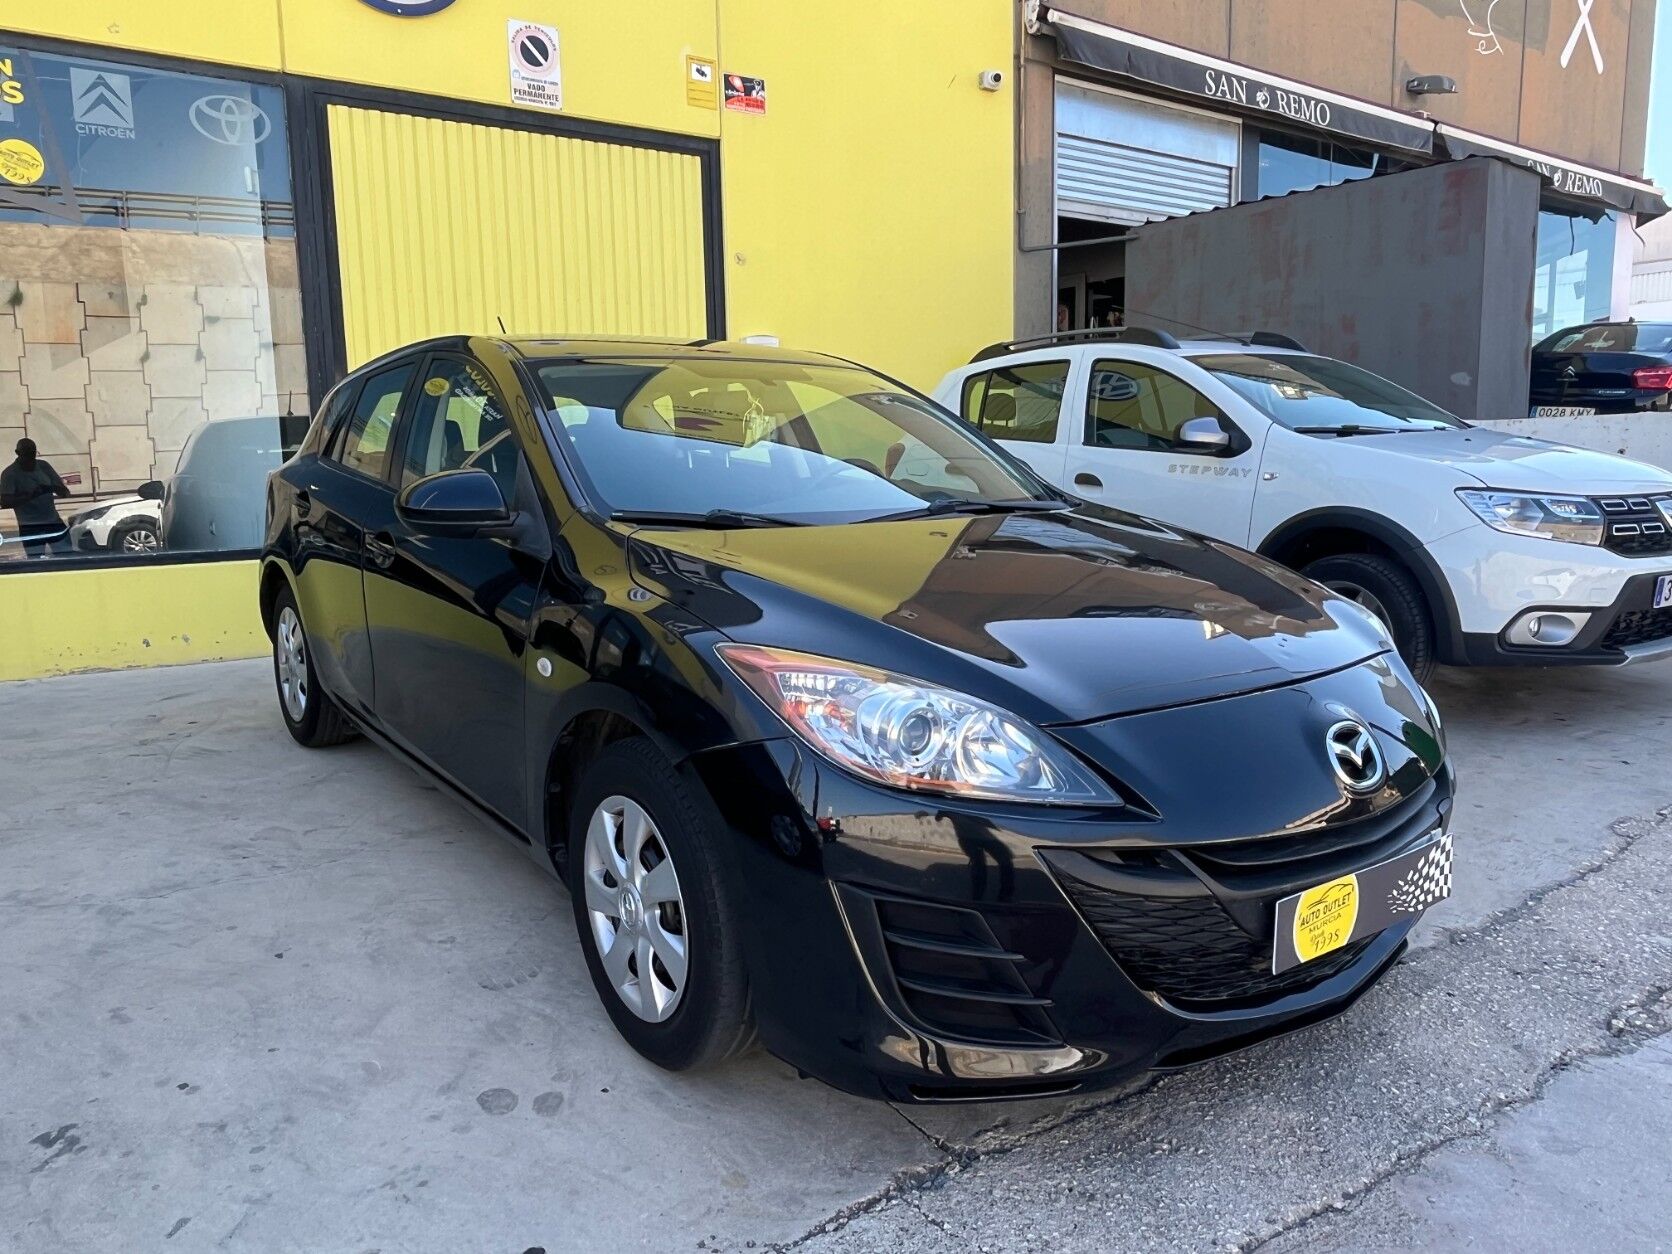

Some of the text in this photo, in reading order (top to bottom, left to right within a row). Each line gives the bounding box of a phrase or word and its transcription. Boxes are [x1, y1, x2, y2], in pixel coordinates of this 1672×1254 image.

[513, 87, 560, 102] PERMANENTE
[527, 82, 546, 93] VADO
[1204, 70, 1330, 126] SAN REMO
[1564, 171, 1603, 197] REMO
[1538, 407, 1566, 418] 0028
[1167, 463, 1252, 478] STEPWAY
[1300, 892, 1352, 927] AUTO OUTLET
[1308, 912, 1342, 934] MURCIA
[1314, 928, 1340, 952] 1995
